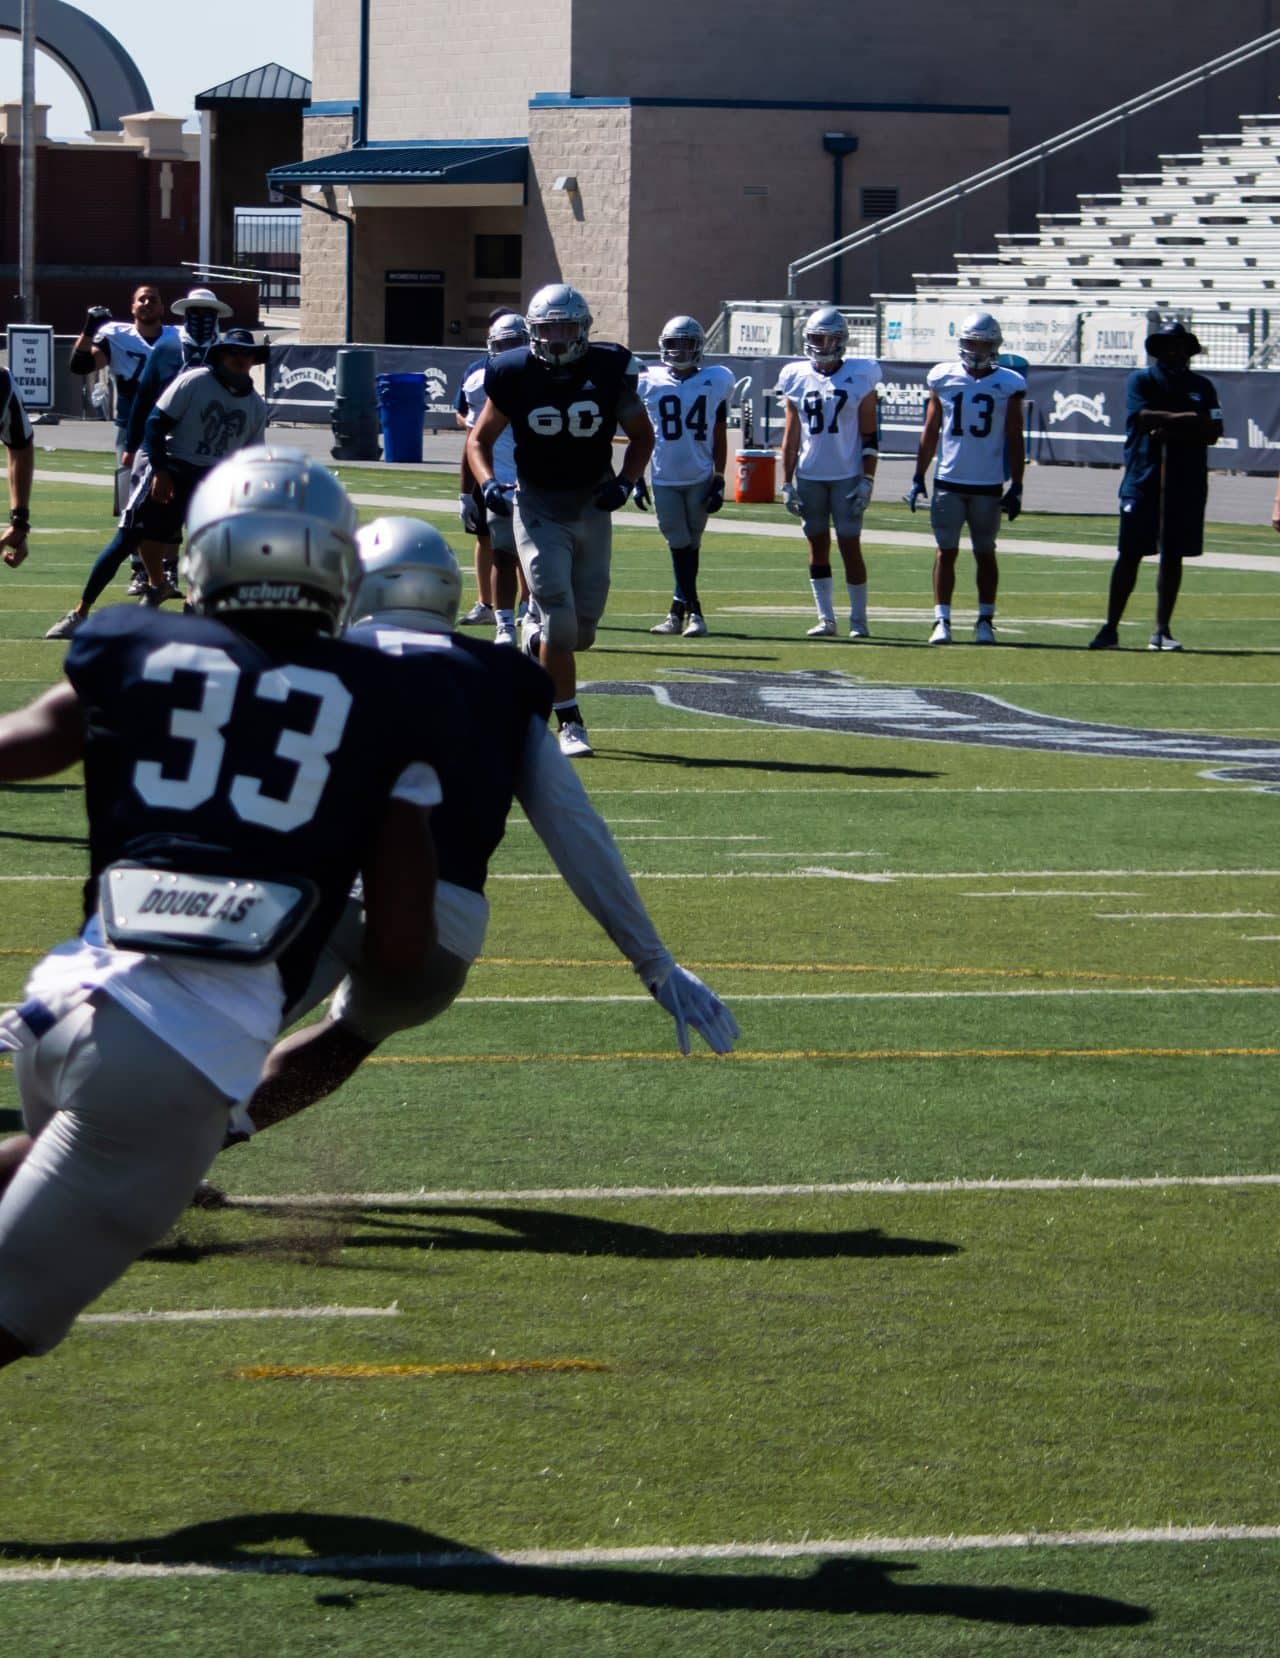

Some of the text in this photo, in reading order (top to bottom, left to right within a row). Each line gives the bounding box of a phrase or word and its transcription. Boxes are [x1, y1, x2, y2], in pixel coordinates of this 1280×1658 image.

[740, 324, 771, 343] FAMILY
[1096, 330, 1134, 350] FAMILY
[658, 395, 708, 442] 84
[804, 388, 848, 435] 87
[951, 390, 995, 438] 13
[133, 642, 353, 833] 33
[137, 888, 256, 924] DOUGLAS
